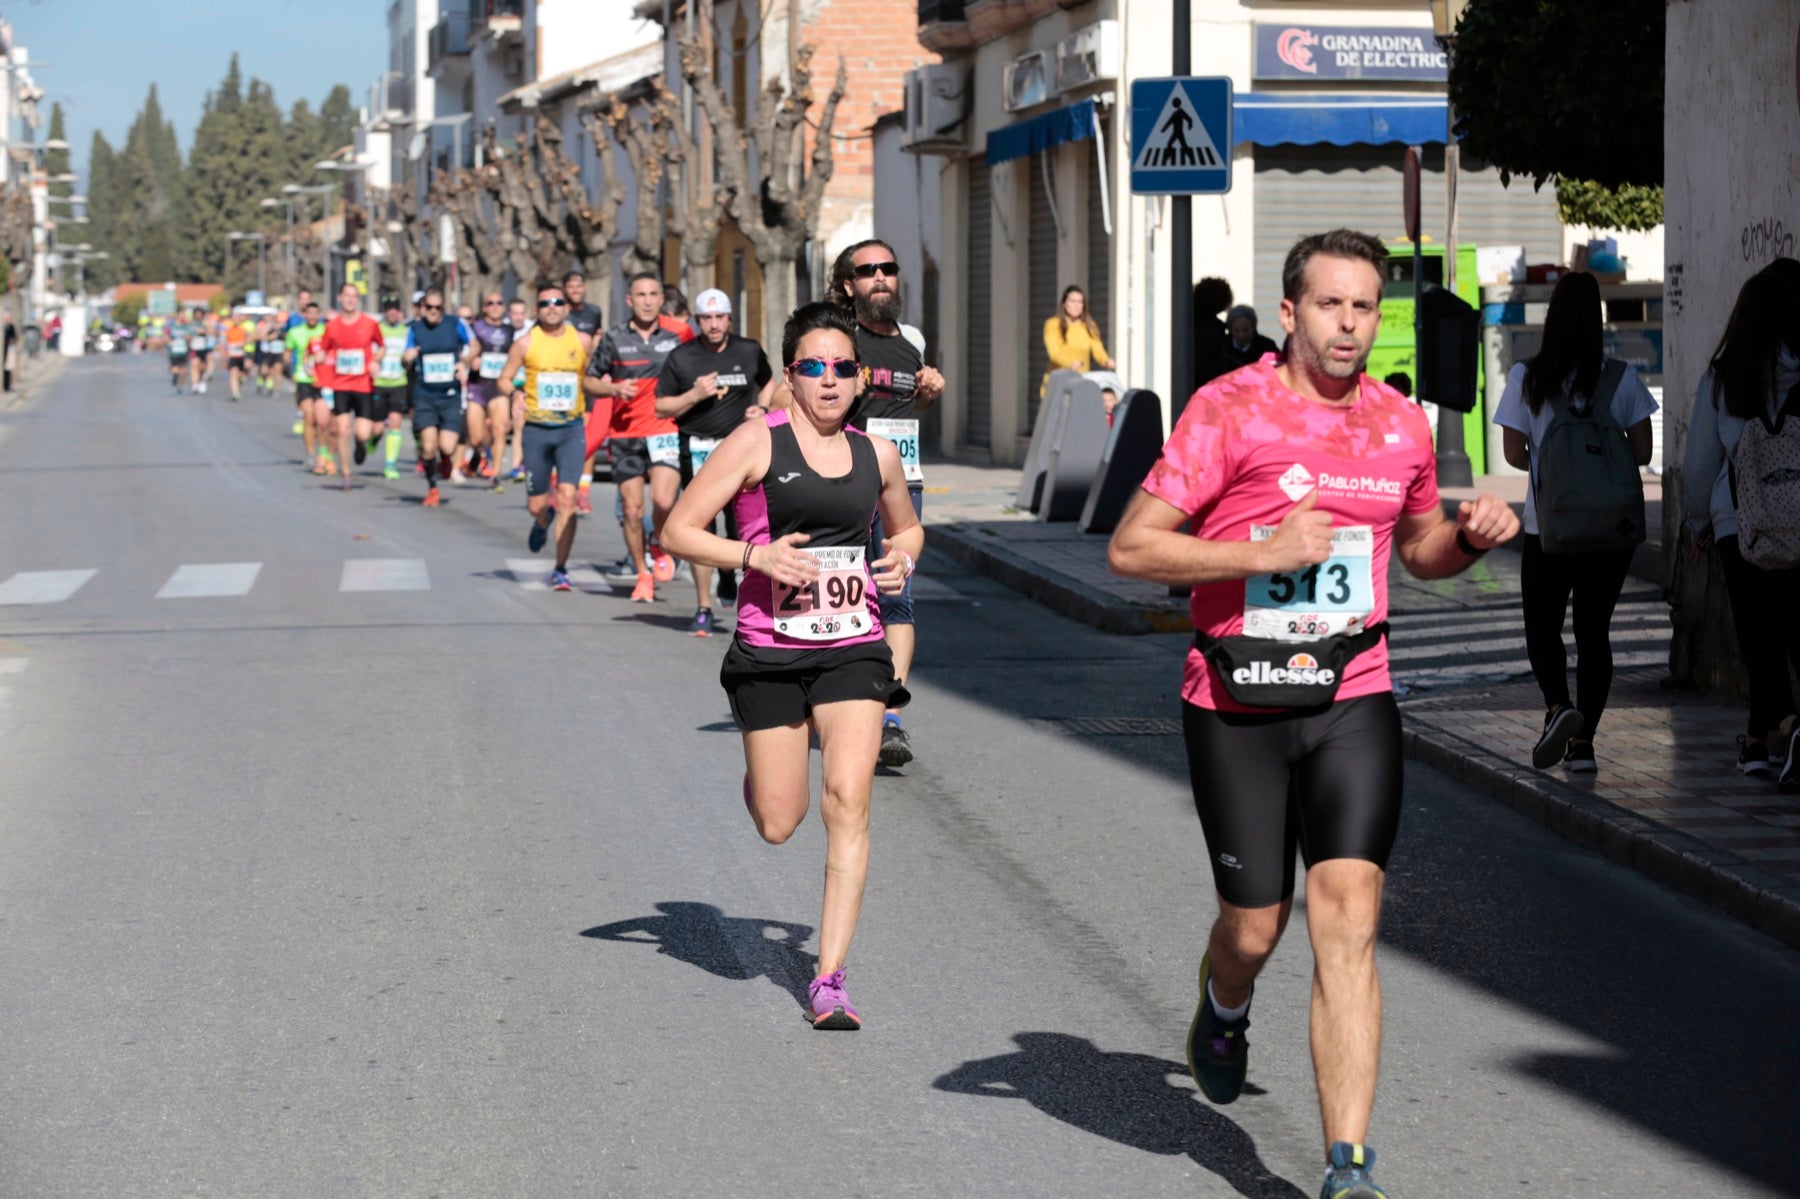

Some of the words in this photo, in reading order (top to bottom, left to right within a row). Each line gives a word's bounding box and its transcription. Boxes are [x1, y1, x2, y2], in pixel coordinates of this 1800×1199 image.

[1322, 35, 1424, 51] GRANADINA
[1336, 52, 1359, 66] DE
[1363, 52, 1447, 68] ELECTRIC
[545, 384, 572, 398] 938
[1319, 473, 1359, 490] PABLO
[1360, 476, 1401, 495] MUÑOZ
[778, 575, 864, 611] 2190
[1268, 563, 1351, 605] 513
[1232, 661, 1335, 685] ellesse
